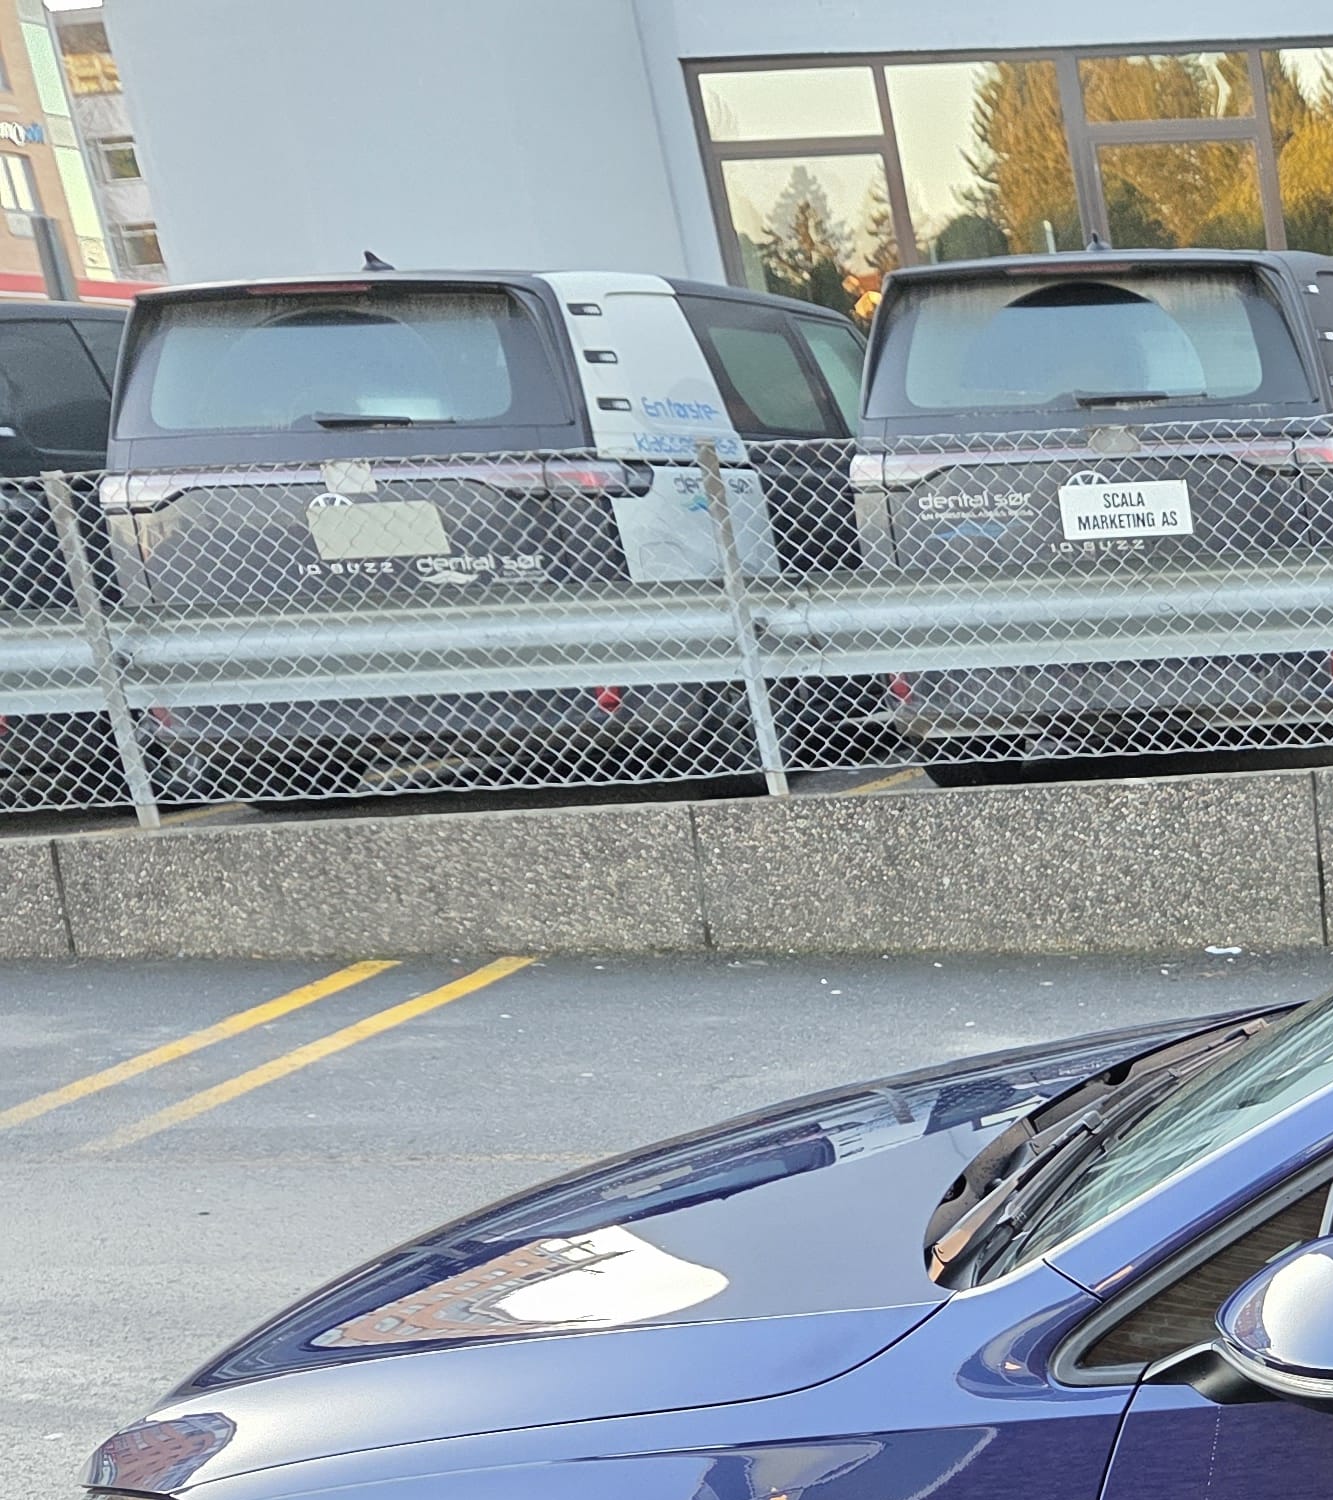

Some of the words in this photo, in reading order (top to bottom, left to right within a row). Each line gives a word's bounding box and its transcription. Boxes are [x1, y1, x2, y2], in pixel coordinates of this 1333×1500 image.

[918, 490, 989, 510] dental
[1103, 491, 1145, 508] SCALA
[1077, 511, 1156, 531] MARKETING
[1161, 510, 1178, 527] AS
